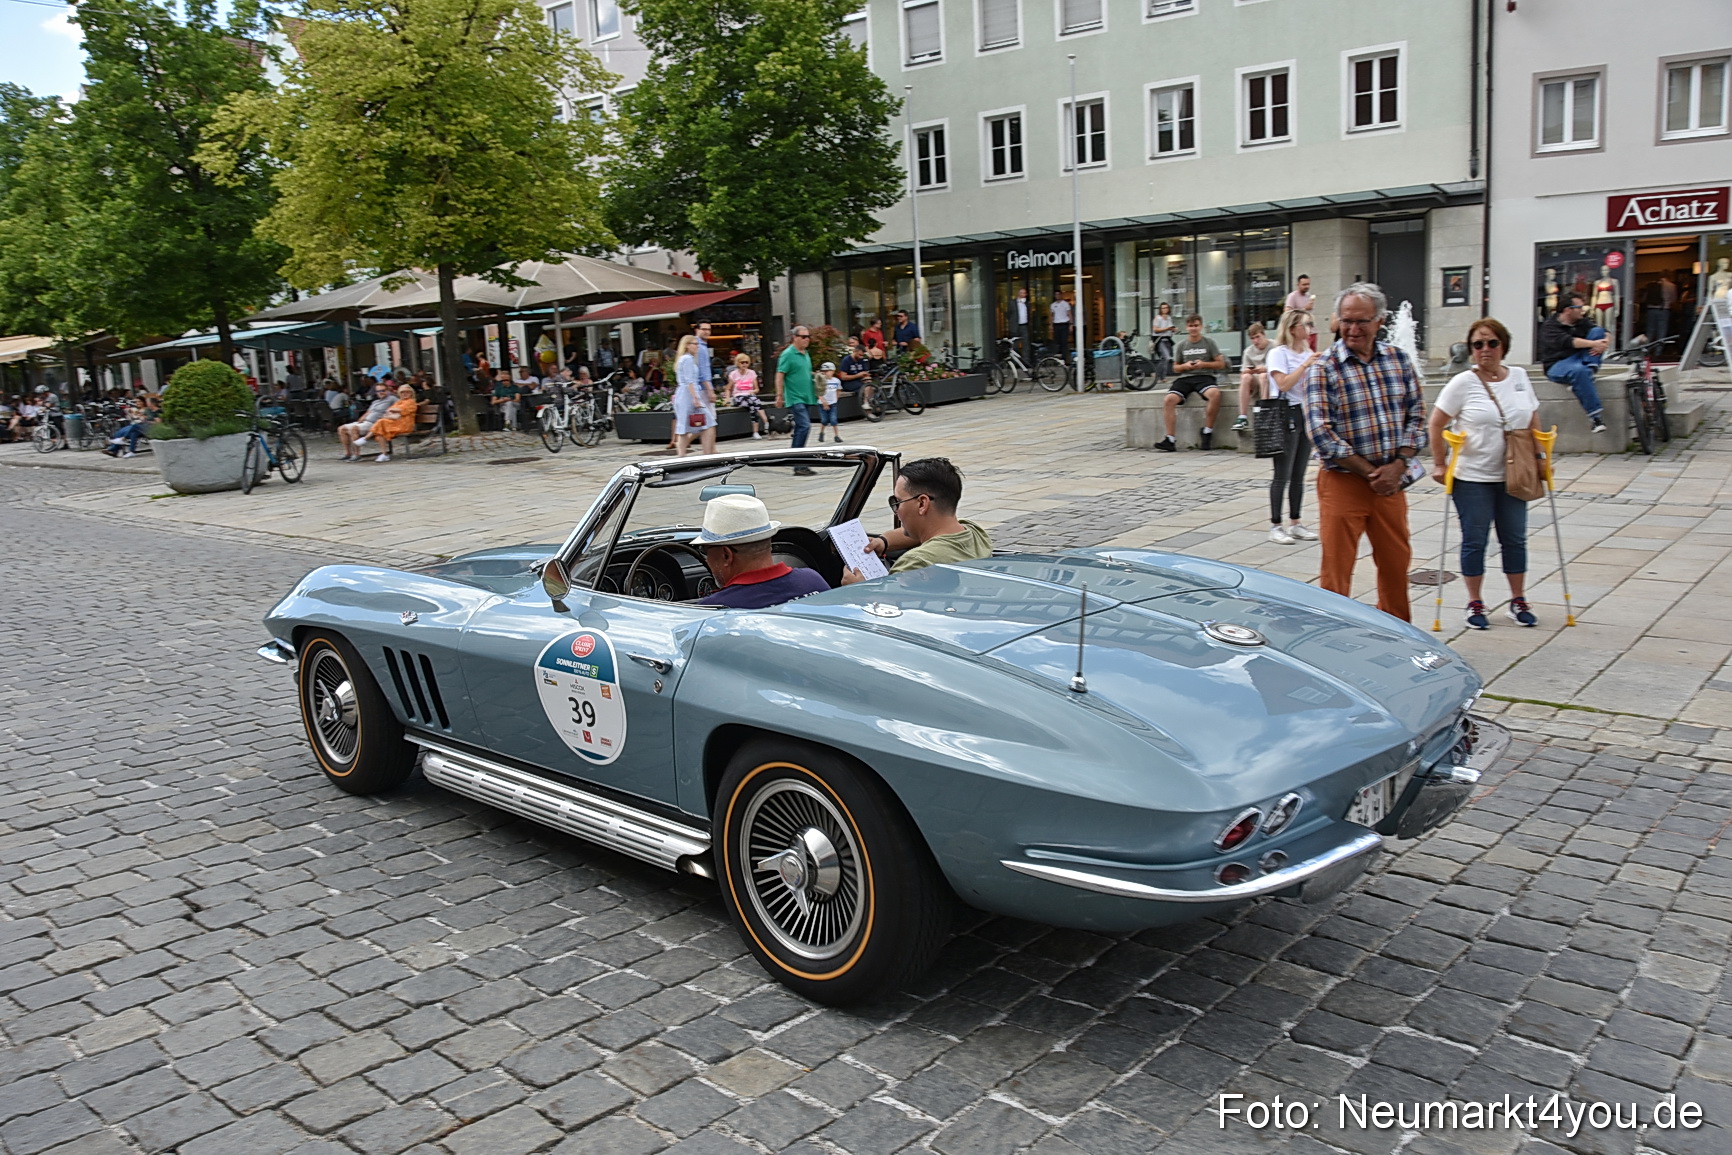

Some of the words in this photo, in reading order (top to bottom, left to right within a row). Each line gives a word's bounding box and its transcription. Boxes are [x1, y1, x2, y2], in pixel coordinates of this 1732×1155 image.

[1616, 196, 1720, 227] Achatz
[556, 657, 590, 671] SONNLEITNER
[568, 696, 596, 727] 39
